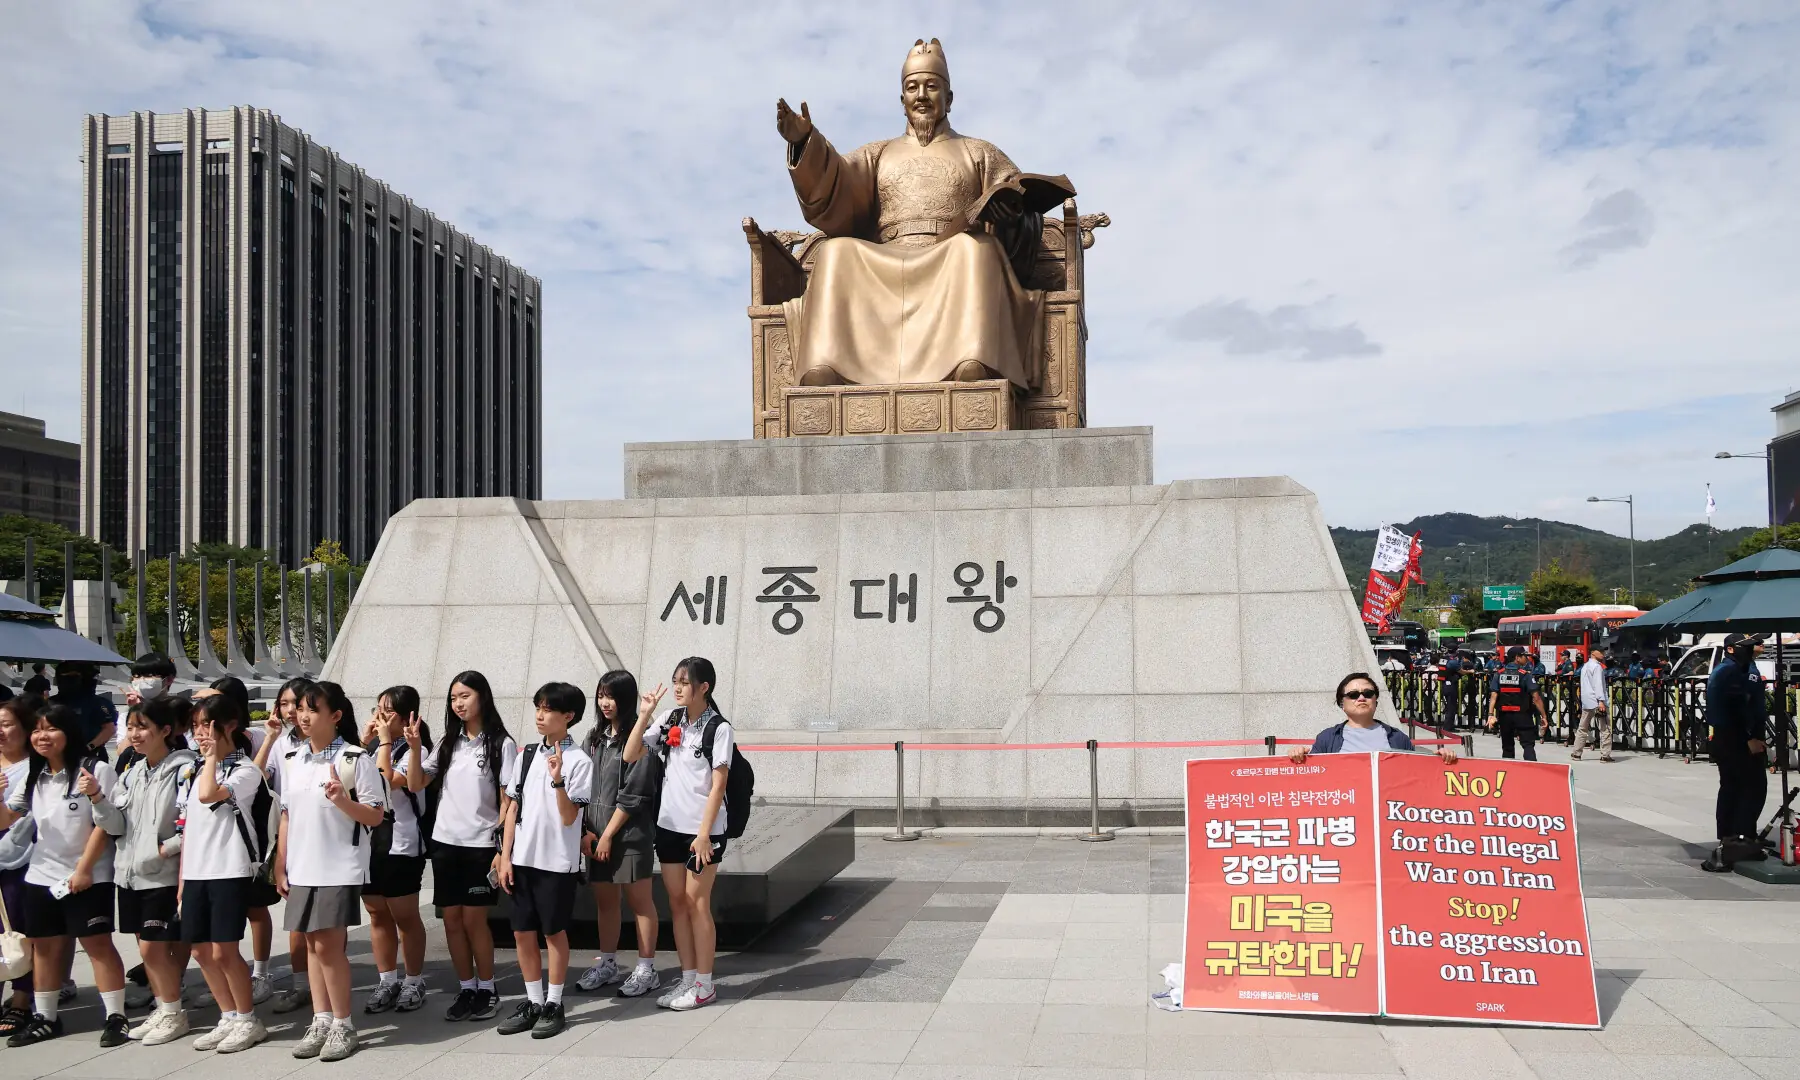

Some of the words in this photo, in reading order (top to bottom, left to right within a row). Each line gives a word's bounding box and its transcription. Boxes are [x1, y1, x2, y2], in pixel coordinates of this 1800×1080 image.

[660, 560, 1018, 635] 세종대왕
[1264, 767, 1279, 776] 파병
[1280, 766, 1295, 775] 반대
[1444, 771, 1507, 798] No!
[1204, 792, 1255, 810] 불법적인
[1258, 791, 1285, 807] 이란
[1288, 788, 1355, 808] 침략전쟁에
[1205, 818, 1291, 849] 한국군
[1297, 816, 1357, 847] 파병
[1386, 800, 1475, 826] Korean
[1479, 806, 1566, 836] Troops
[1391, 828, 1429, 852] for
[1434, 833, 1475, 855] the
[1480, 835, 1560, 864] Illegal
[1222, 854, 1341, 885] 강압하는
[1404, 861, 1458, 884] War
[1463, 868, 1497, 887] on
[1501, 866, 1556, 891] Iran
[1230, 894, 1333, 933] 미국을
[1448, 896, 1521, 926] Stop!
[1388, 924, 1433, 947] the
[1439, 930, 1585, 956] aggression
[1204, 940, 1364, 978] 규탄한다!
[1439, 963, 1475, 982] on
[1480, 961, 1538, 985] Iran
[1476, 1002, 1505, 1013] SPARK
